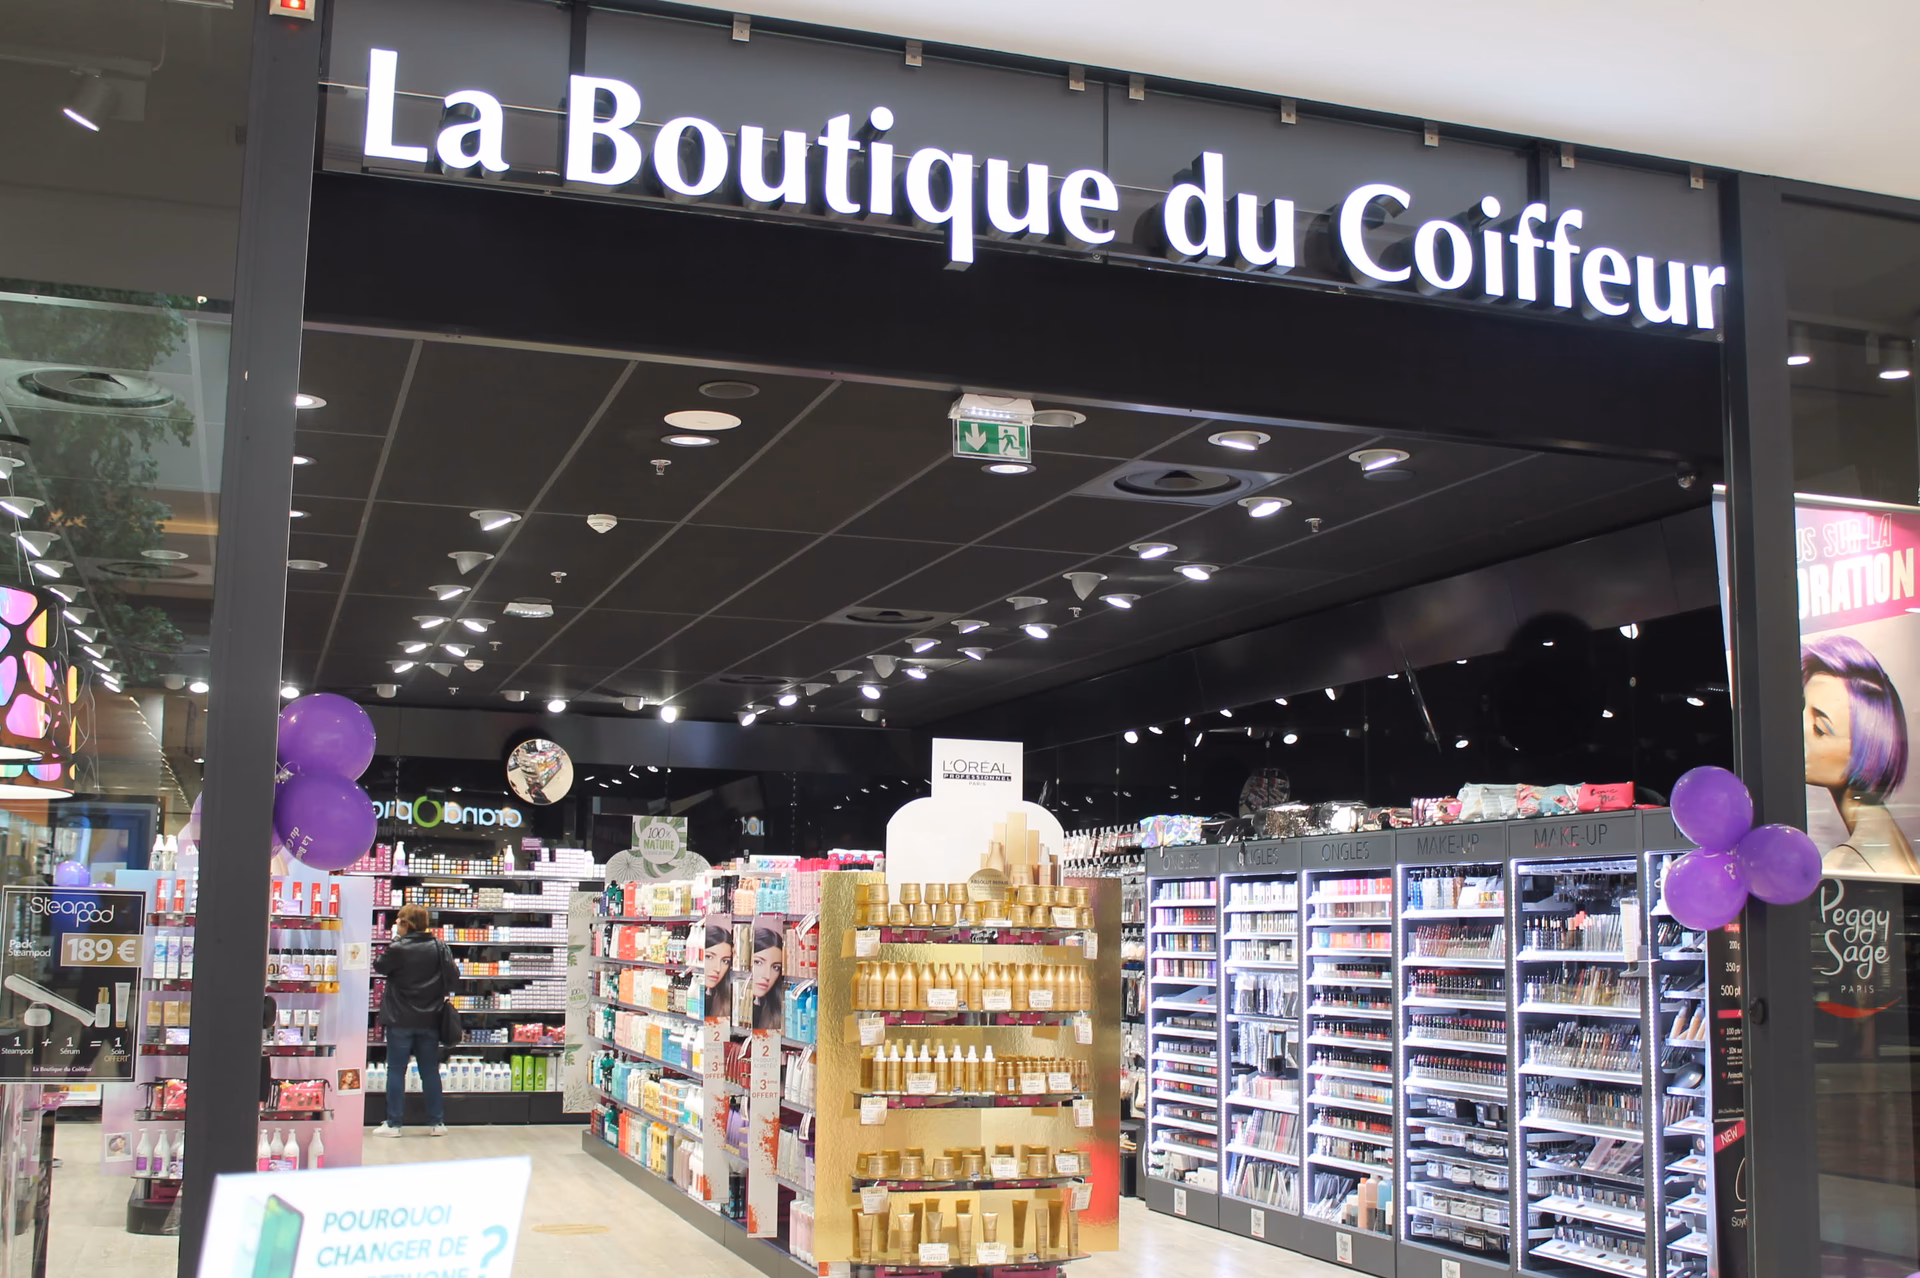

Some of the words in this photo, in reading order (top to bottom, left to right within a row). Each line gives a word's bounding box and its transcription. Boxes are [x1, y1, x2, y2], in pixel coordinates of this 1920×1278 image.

[364, 48, 510, 173] La
[565, 75, 1119, 263] Boutique
[1164, 152, 1295, 270] du
[1339, 183, 1725, 330] Coiffeur
[1868, 513, 1892, 550] LA
[942, 758, 1012, 775] L'ORÉAL
[942, 773, 1012, 782] PROFESSIONNEL
[290, 826, 300, 839] du
[648, 827, 672, 839] 100%
[1533, 823, 1608, 849] MAKE-UP
[301, 835, 314, 846] La
[643, 839, 676, 851] NATURE
[1417, 834, 1480, 856] MAKE-UP
[1321, 841, 1370, 862] ONGLES
[1162, 852, 1200, 871] ONGLES
[29, 896, 97, 916] Steam
[1820, 879, 1890, 945] Peggy
[76, 904, 115, 928] pod
[8, 948, 52, 958] Steampod
[67, 938, 114, 963] 189
[1820, 929, 1890, 980] Sage
[1725, 962, 1736, 972] 350
[1720, 984, 1734, 996] 500
[1840, 985, 1875, 994] PARIS
[14, 1036, 21, 1047] 1
[66, 1036, 74, 1047] 1
[114, 1036, 122, 1047] 1
[713, 1031, 720, 1042] 2
[1, 1047, 34, 1056] Steampod
[60, 1047, 81, 1056] Sérum
[111, 1048, 125, 1056] Soin
[762, 1045, 770, 1057] 2
[751, 1091, 778, 1099] OFFERT
[1719, 1125, 1739, 1146] NEW
[322, 1204, 453, 1234] POURQUOI
[316, 1239, 432, 1268] CHANGER
[437, 1235, 469, 1258] DE
